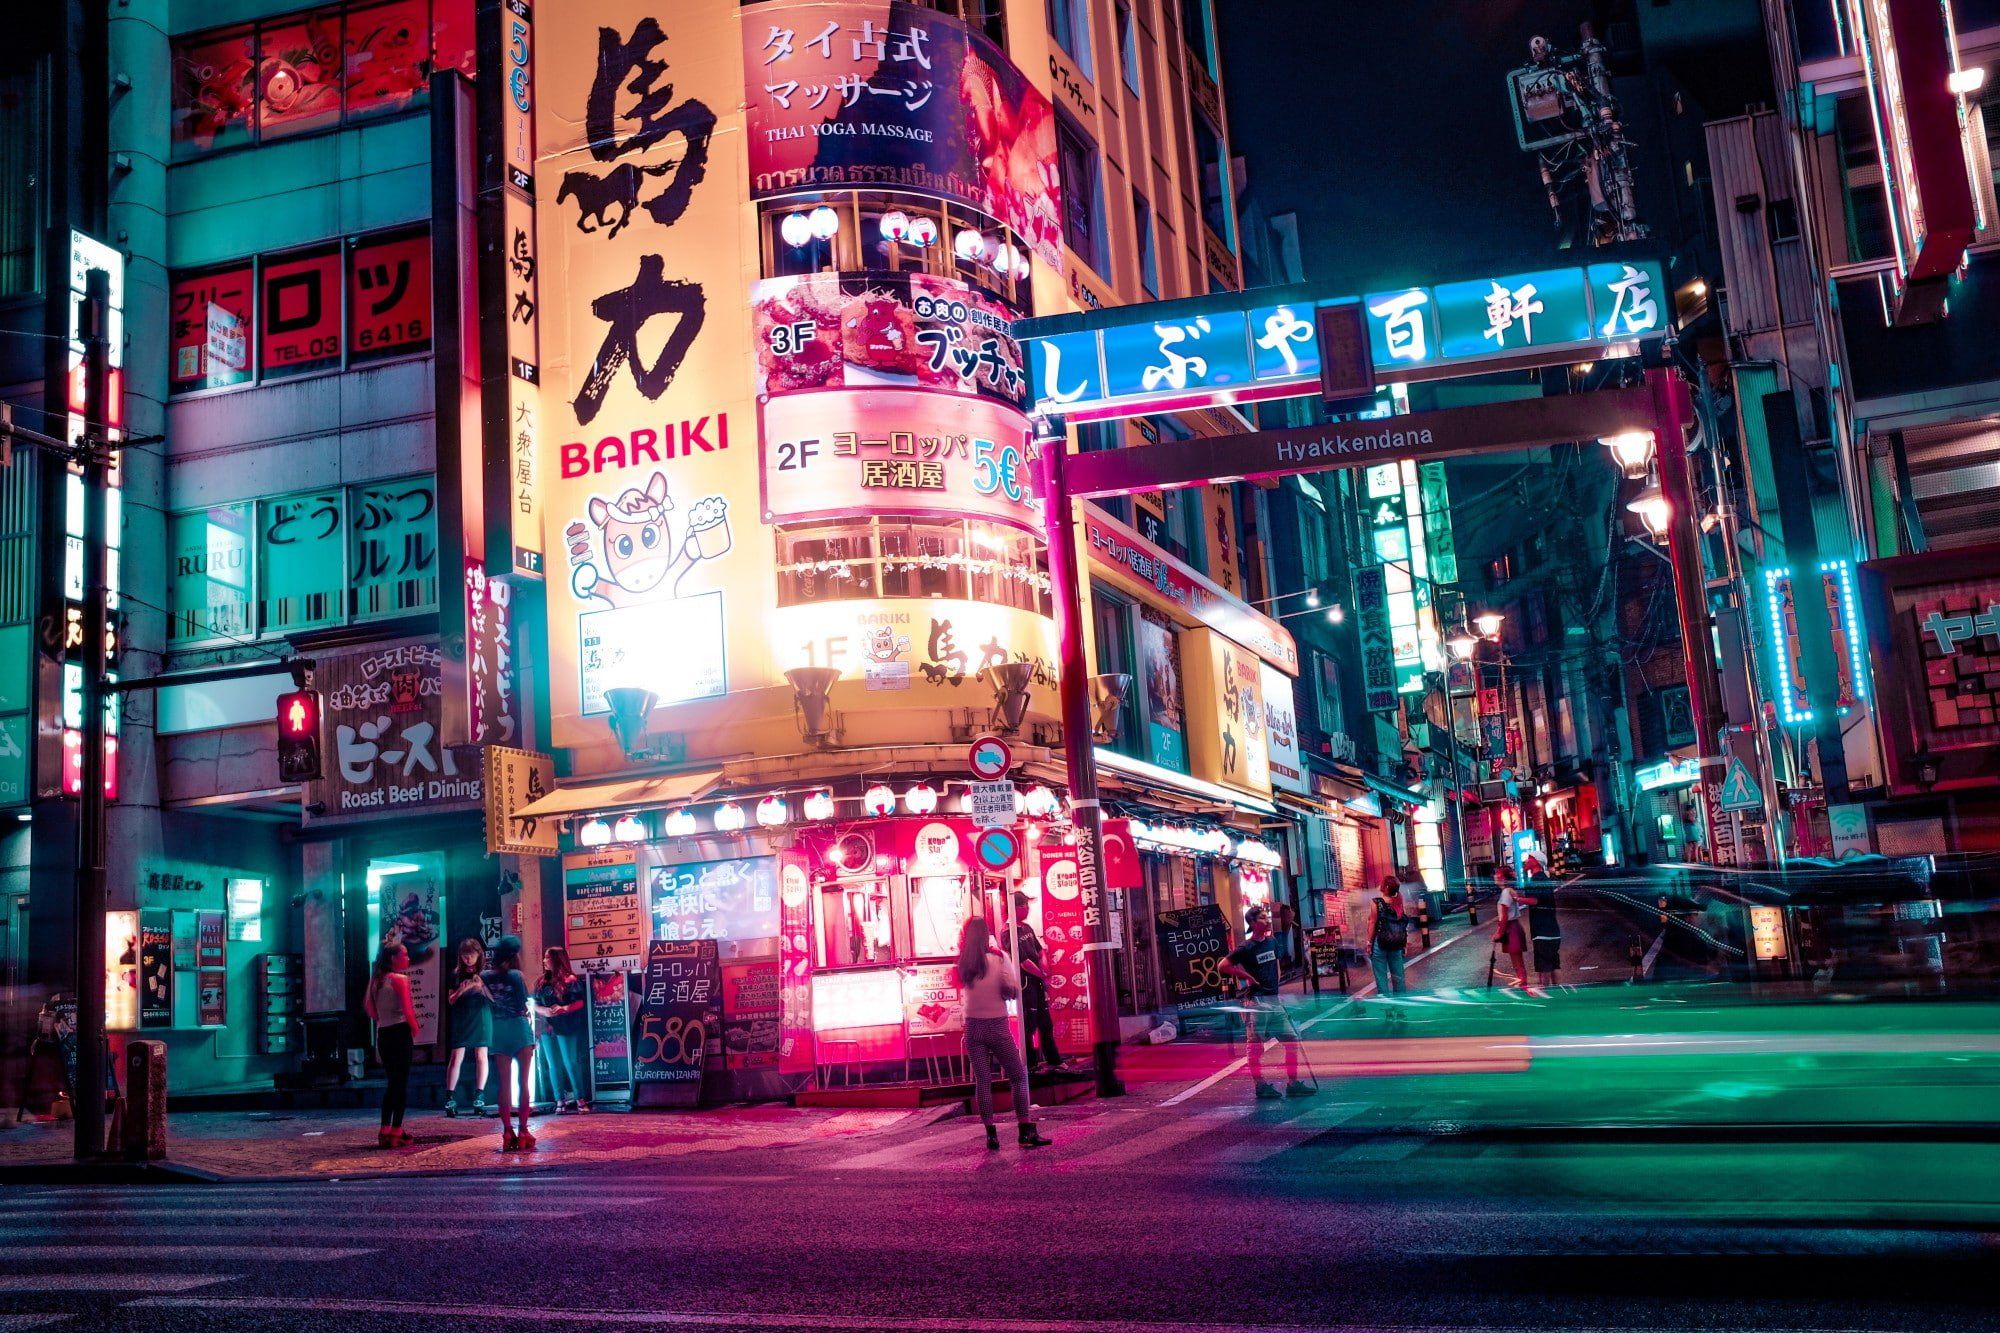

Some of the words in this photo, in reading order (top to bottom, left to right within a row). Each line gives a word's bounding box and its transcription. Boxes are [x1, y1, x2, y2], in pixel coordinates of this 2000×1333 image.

[762, 20, 933, 70] タイ古式
[764, 72, 934, 112] マッサージ
[766, 124, 806, 143] THAI
[812, 122, 857, 137] YOGA
[861, 122, 934, 143] MASSAGE
[513, 171, 529, 188] 2F
[556, 17, 717, 426] 馬力
[914, 296, 968, 324] お肉の
[970, 308, 1013, 338] 創作居酒
[359, 320, 424, 347] 6416
[771, 321, 816, 356] 3F
[517, 361, 534, 380] 1F
[515, 401, 533, 515] 大衆屋台
[560, 411, 730, 480] BARIKI
[777, 440, 820, 471] 2F
[832, 431, 968, 458] ヨーロッパ
[1276, 427, 1434, 462] Hyakkendana
[860, 460, 945, 490] 居酒屋
[972, 438, 1021, 501] 5€
[266, 488, 434, 545] どうぶつ
[176, 547, 244, 577] RURU
[351, 531, 436, 583] ルル
[522, 551, 538, 570] 1F
[488, 580, 515, 743] ローストビーフ
[1014, 651, 1058, 692] 谷店
[342, 786, 385, 809] Roast
[389, 783, 425, 804] Beef
[428, 779, 481, 800] Dining
[622, 882, 636, 893] 5F
[202, 923, 221, 934] FAST
[202, 935, 221, 946] NAIL
[1174, 938, 1221, 958] FOOD
[652, 960, 713, 978] ヨーロッパ
[646, 979, 711, 1006] 居酒屋
[637, 1016, 706, 1065] 580
